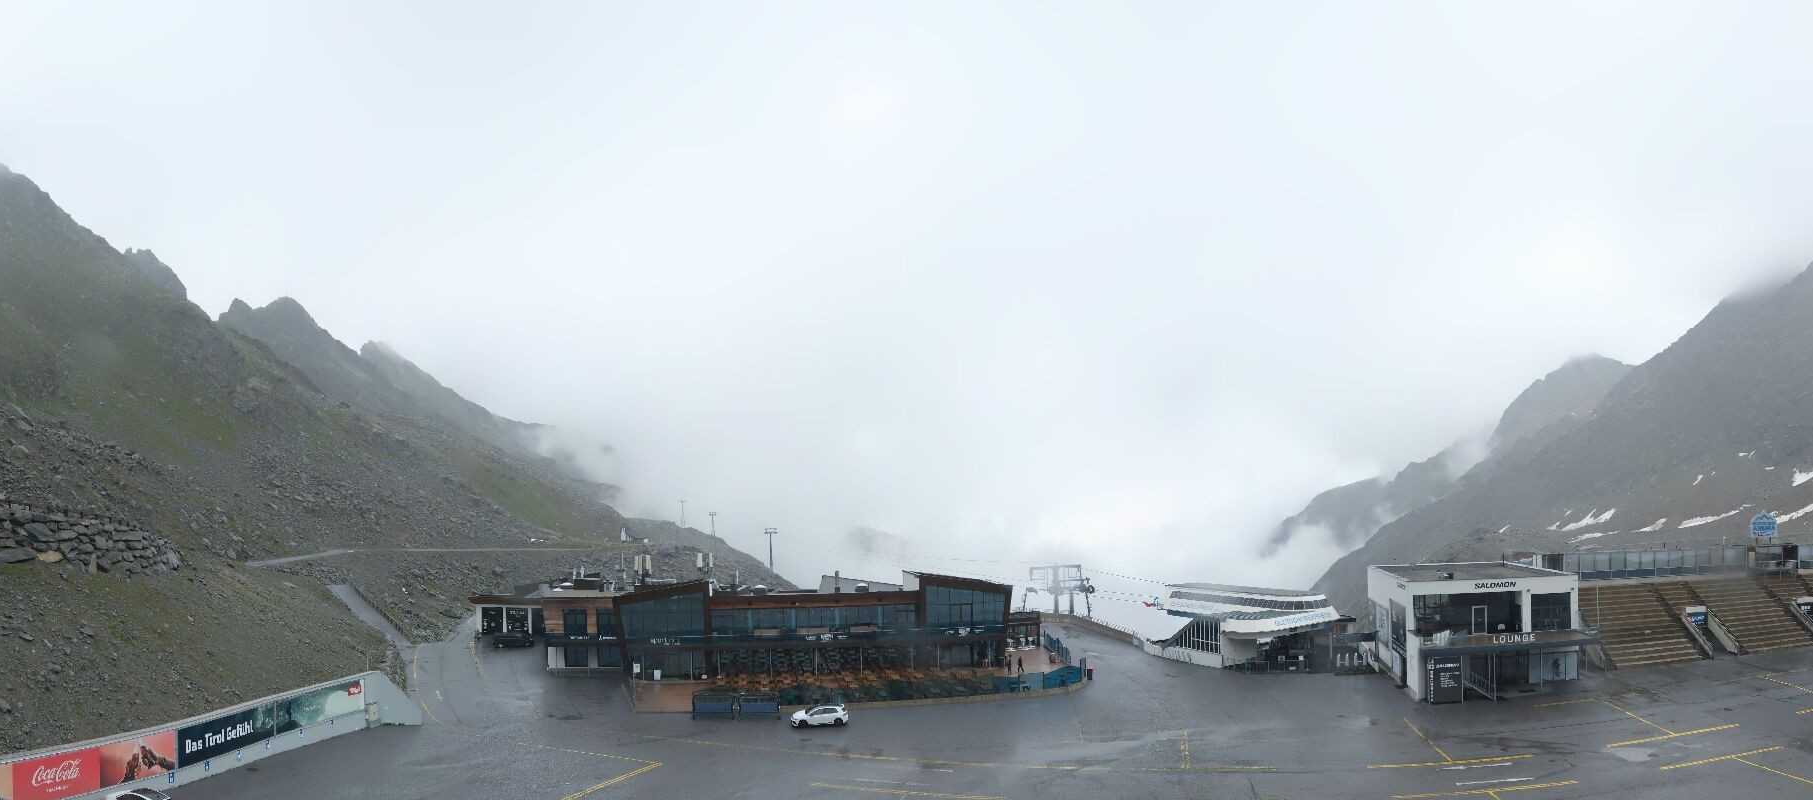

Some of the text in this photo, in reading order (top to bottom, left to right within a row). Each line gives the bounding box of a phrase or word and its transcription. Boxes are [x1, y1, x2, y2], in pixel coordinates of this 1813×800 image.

[1474, 581, 1517, 589] SALOMON
[1493, 633, 1536, 644] LOUNGE
[185, 719, 254, 754] Das Tirol Gefühl
